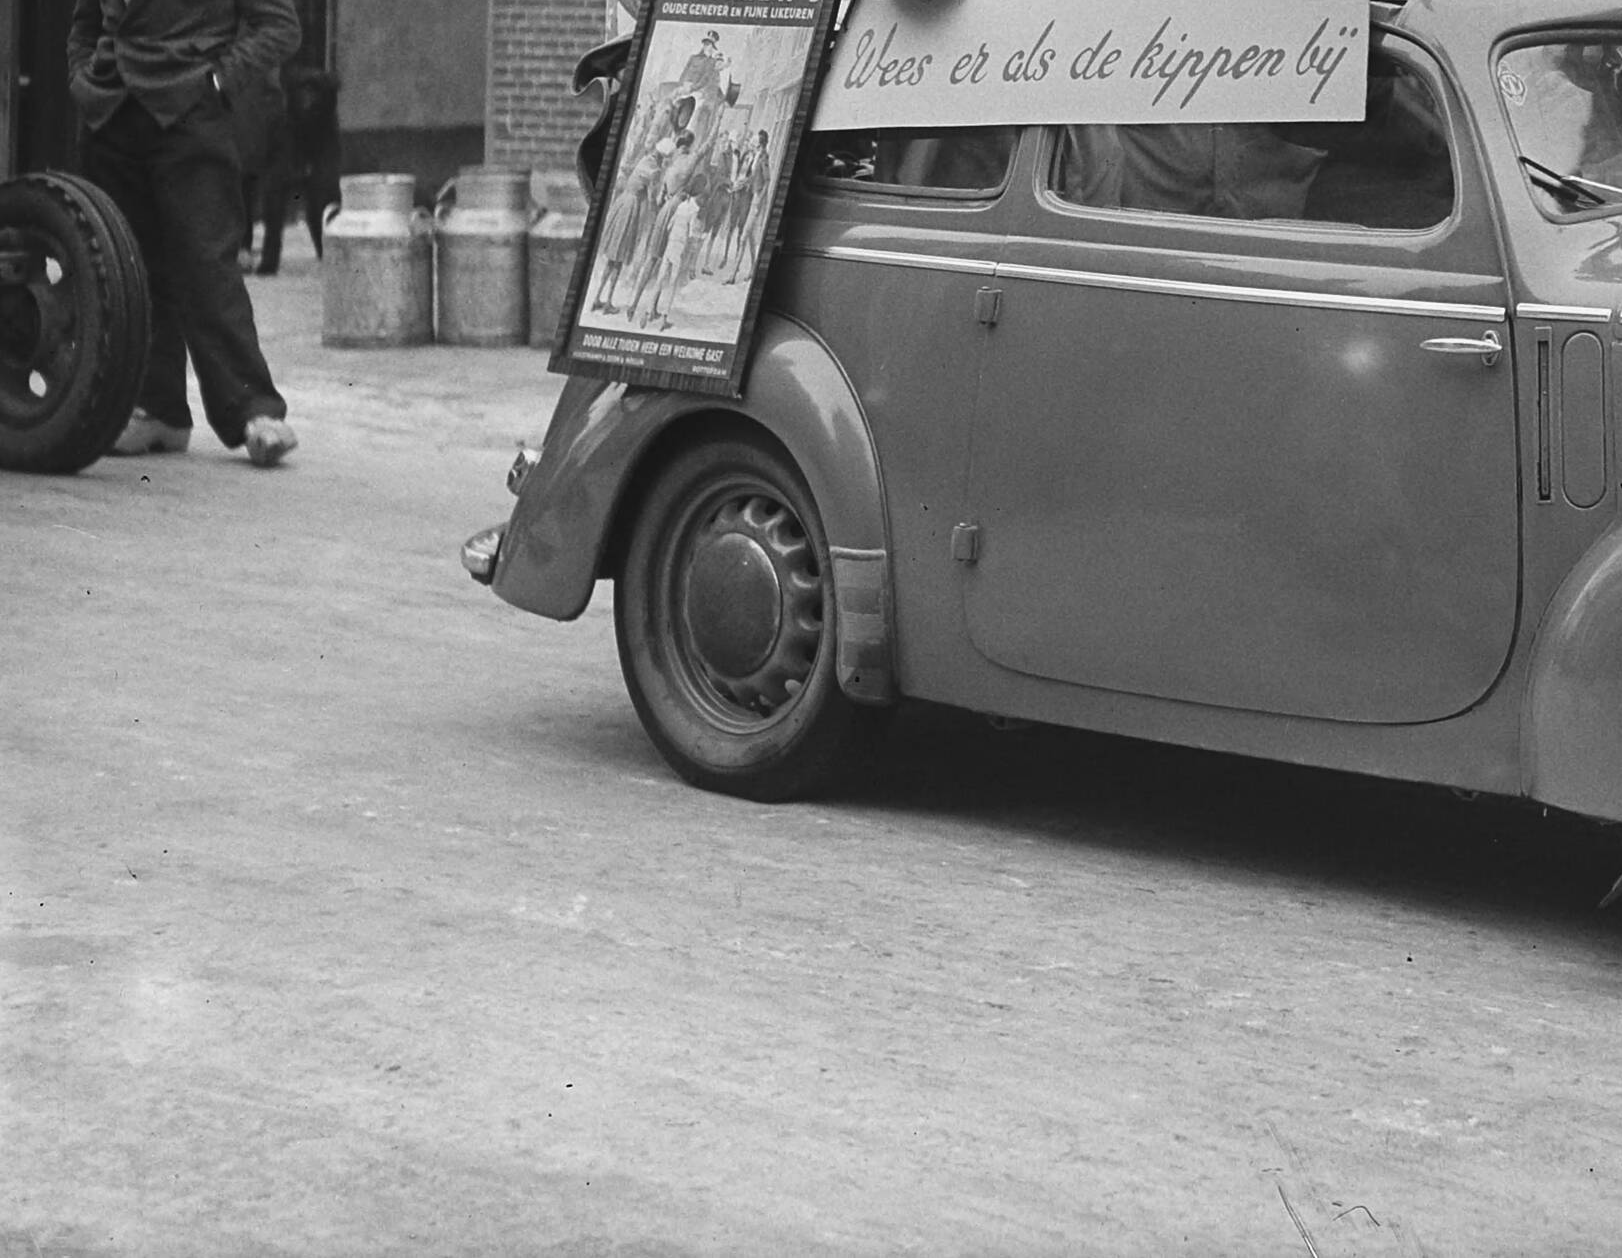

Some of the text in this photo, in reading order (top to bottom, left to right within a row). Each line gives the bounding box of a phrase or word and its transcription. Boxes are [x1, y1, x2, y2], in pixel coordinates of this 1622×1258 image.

[662, 2, 688, 15] OUDE
[770, 7, 815, 20] LIKEUREN
[844, 22, 930, 90] Wees
[949, 43, 990, 85] er
[1002, 19, 1056, 83] als
[1069, 29, 1124, 81] de
[1130, 17, 1287, 110] kippen
[704, 348, 725, 363] GAST
